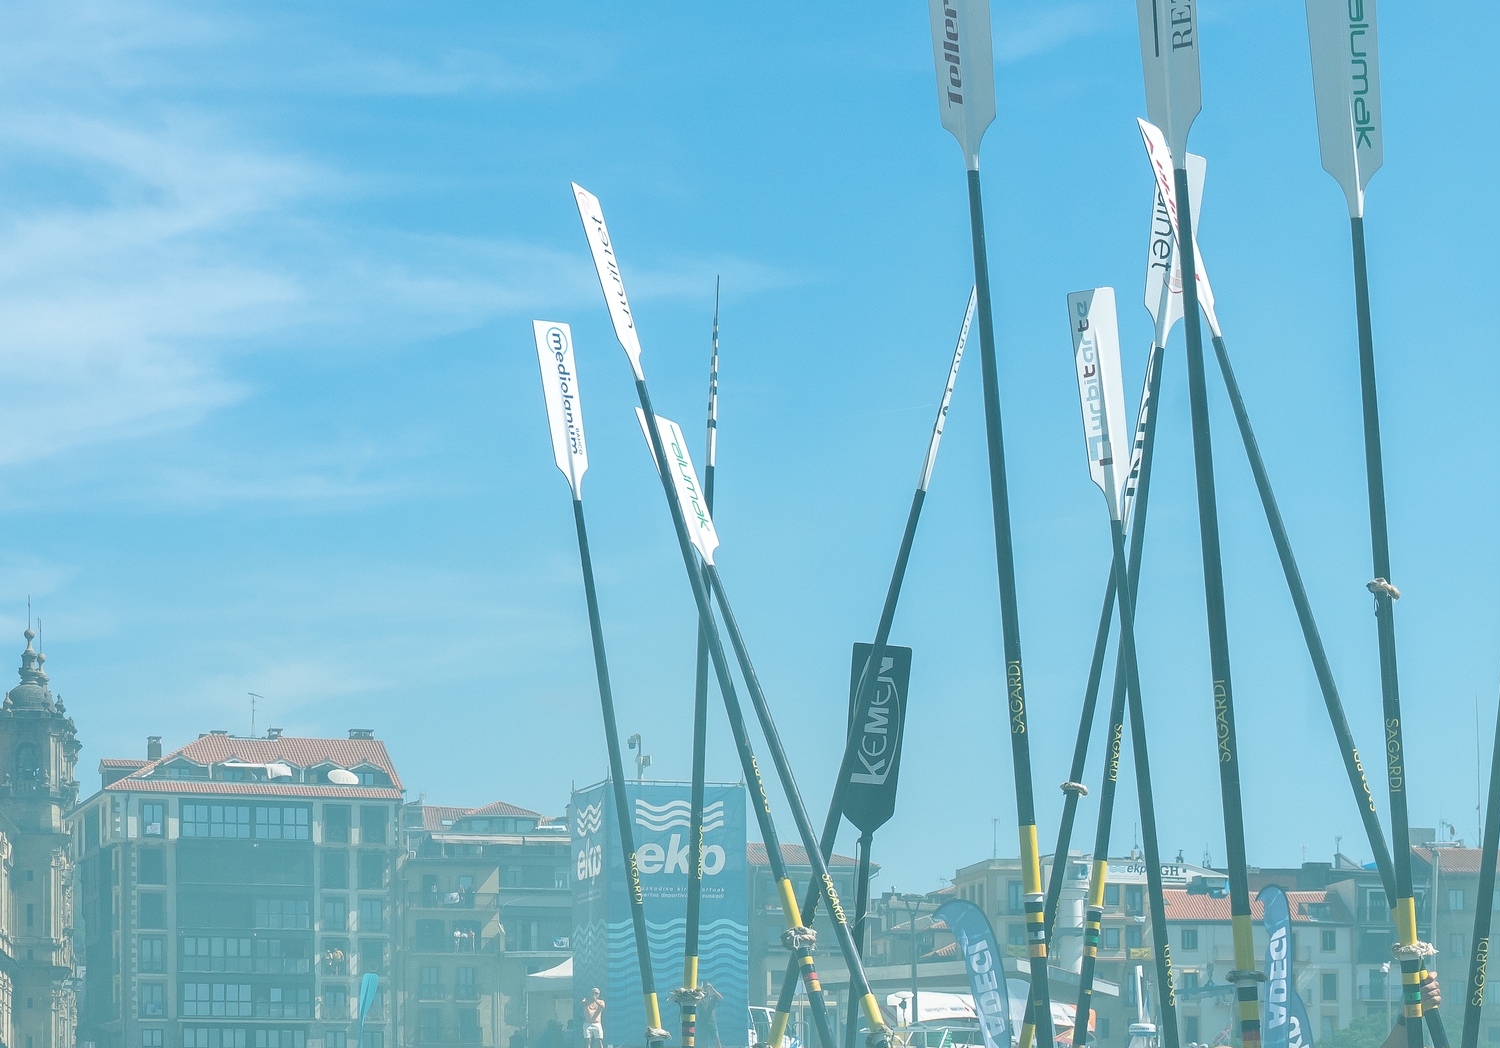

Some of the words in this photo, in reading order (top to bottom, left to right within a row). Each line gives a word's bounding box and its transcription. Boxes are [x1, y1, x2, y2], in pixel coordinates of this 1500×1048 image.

[1171, 0, 1194, 52] RE
[550, 332, 579, 456] mediolanum
[669, 428, 710, 533] alumak
[1008, 660, 1025, 734] SAGARDI
[1214, 680, 1231, 763] SAGARDI
[1109, 723, 1123, 783] SAGARDI
[1385, 718, 1402, 793] SAGARDI
[577, 838, 602, 886] ekp
[629, 852, 643, 906] SAGARDI
[820, 873, 848, 926] SAGARDI
[1472, 936, 1490, 1008] SAGARDI
